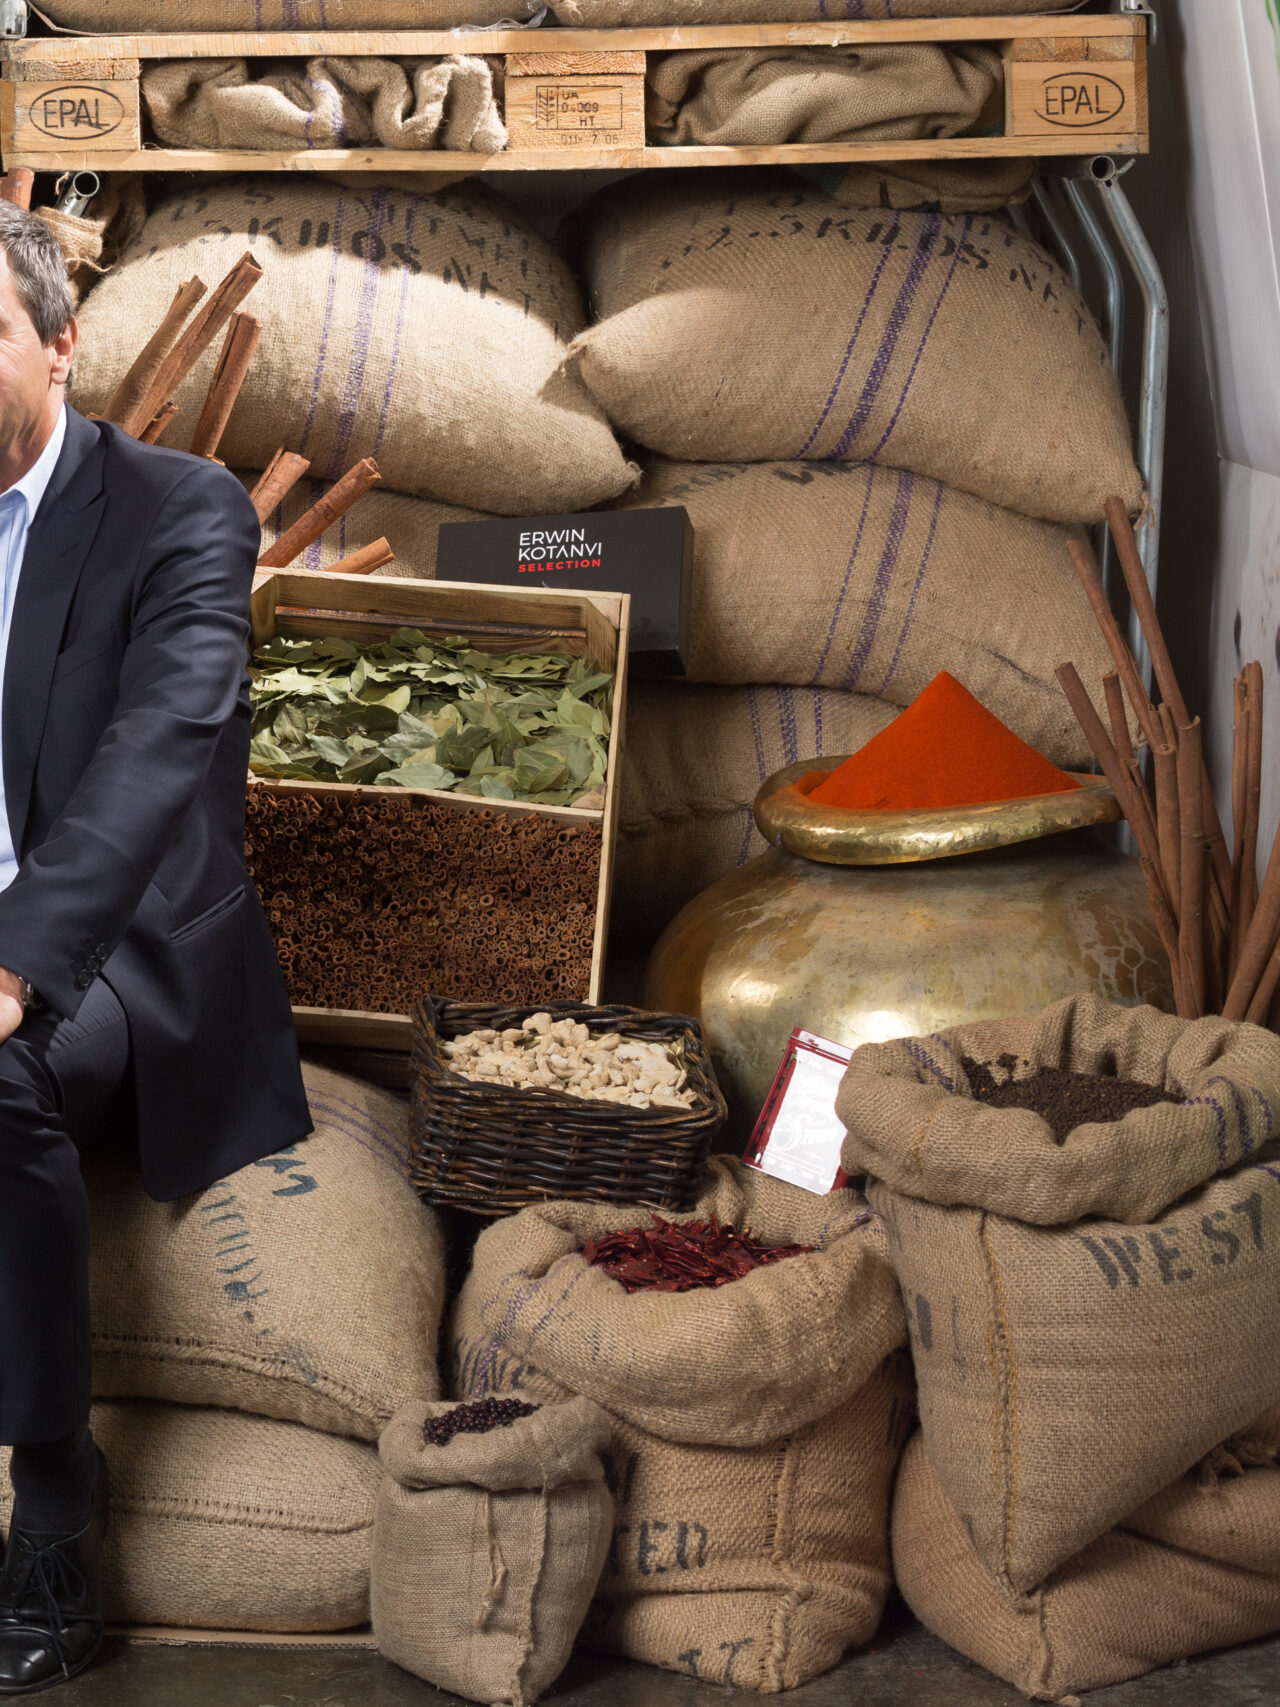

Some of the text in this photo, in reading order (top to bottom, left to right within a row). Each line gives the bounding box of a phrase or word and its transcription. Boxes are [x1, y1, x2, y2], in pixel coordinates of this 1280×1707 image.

[43, 98, 110, 128] EPAL
[1045, 84, 1110, 115] EPAL
[519, 528, 585, 546] ERWIN
[518, 558, 601, 573] SELECTION
[1076, 1191, 1265, 1289] WEST
